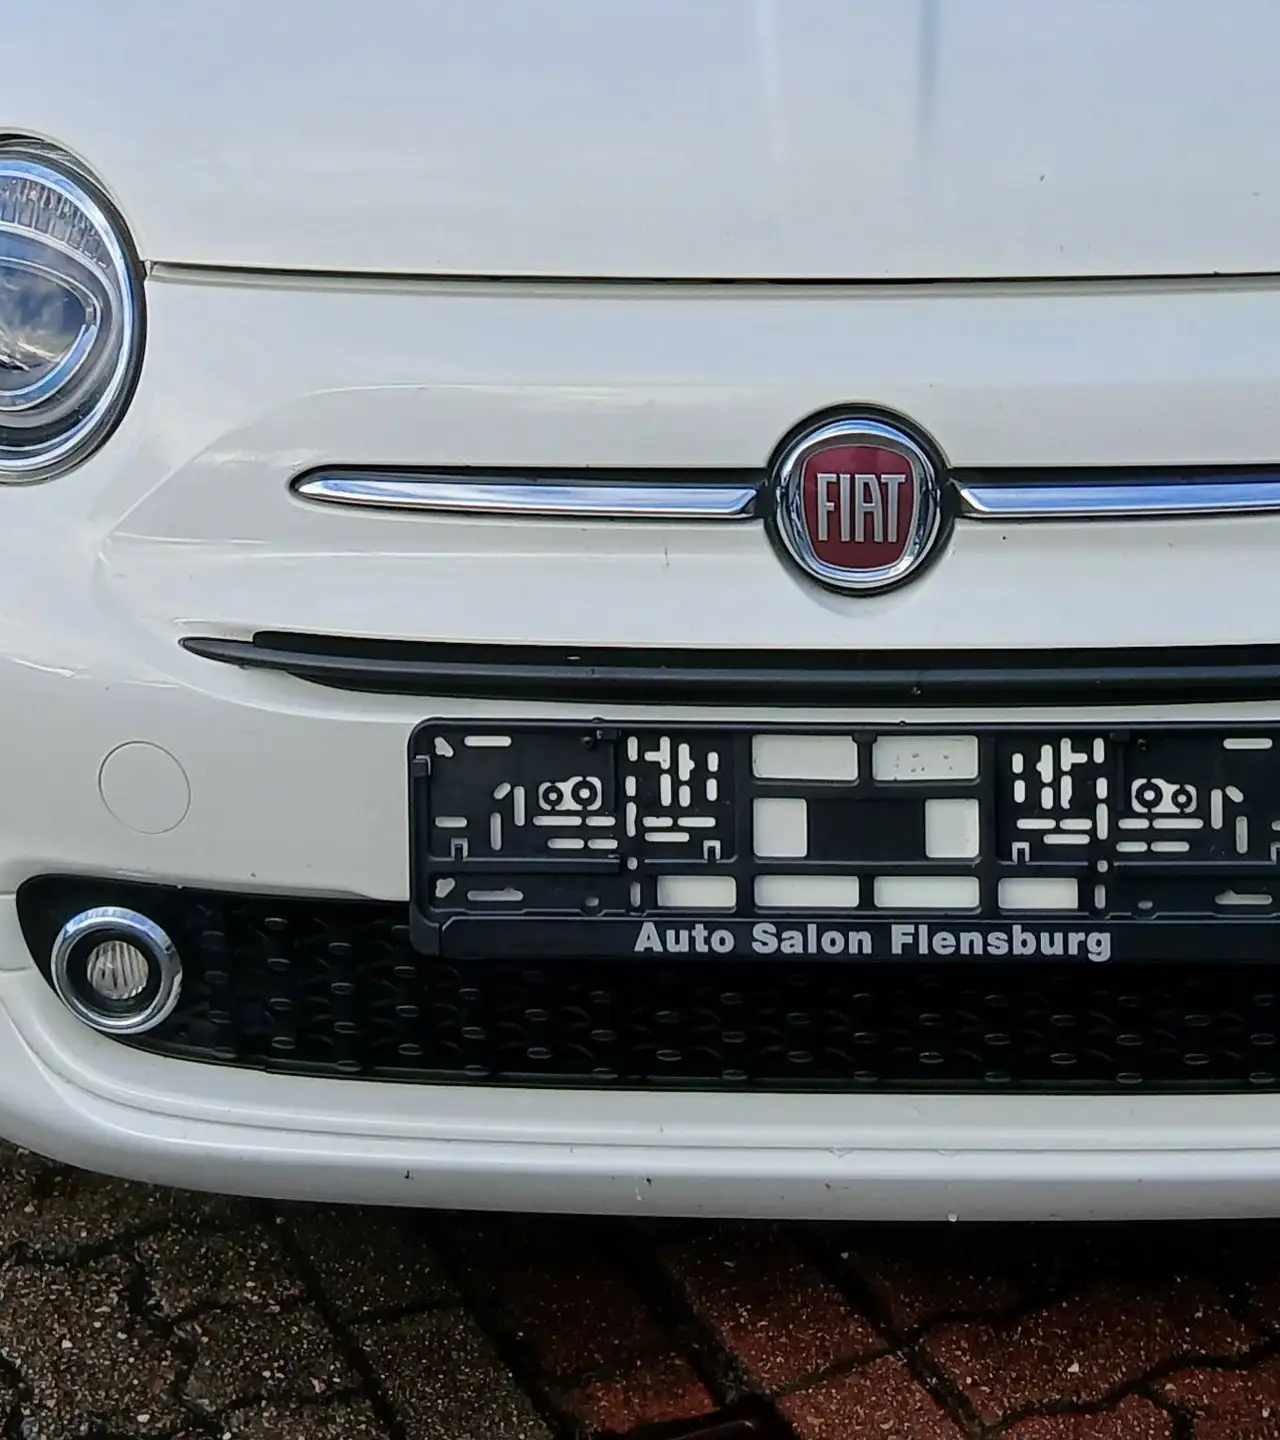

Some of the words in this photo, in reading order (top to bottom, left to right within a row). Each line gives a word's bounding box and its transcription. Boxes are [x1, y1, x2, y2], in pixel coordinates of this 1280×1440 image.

[816, 472, 908, 543] FIAT
[633, 921, 736, 954] Auto
[750, 922, 873, 955] Salon
[890, 923, 1112, 963] Flensburg
